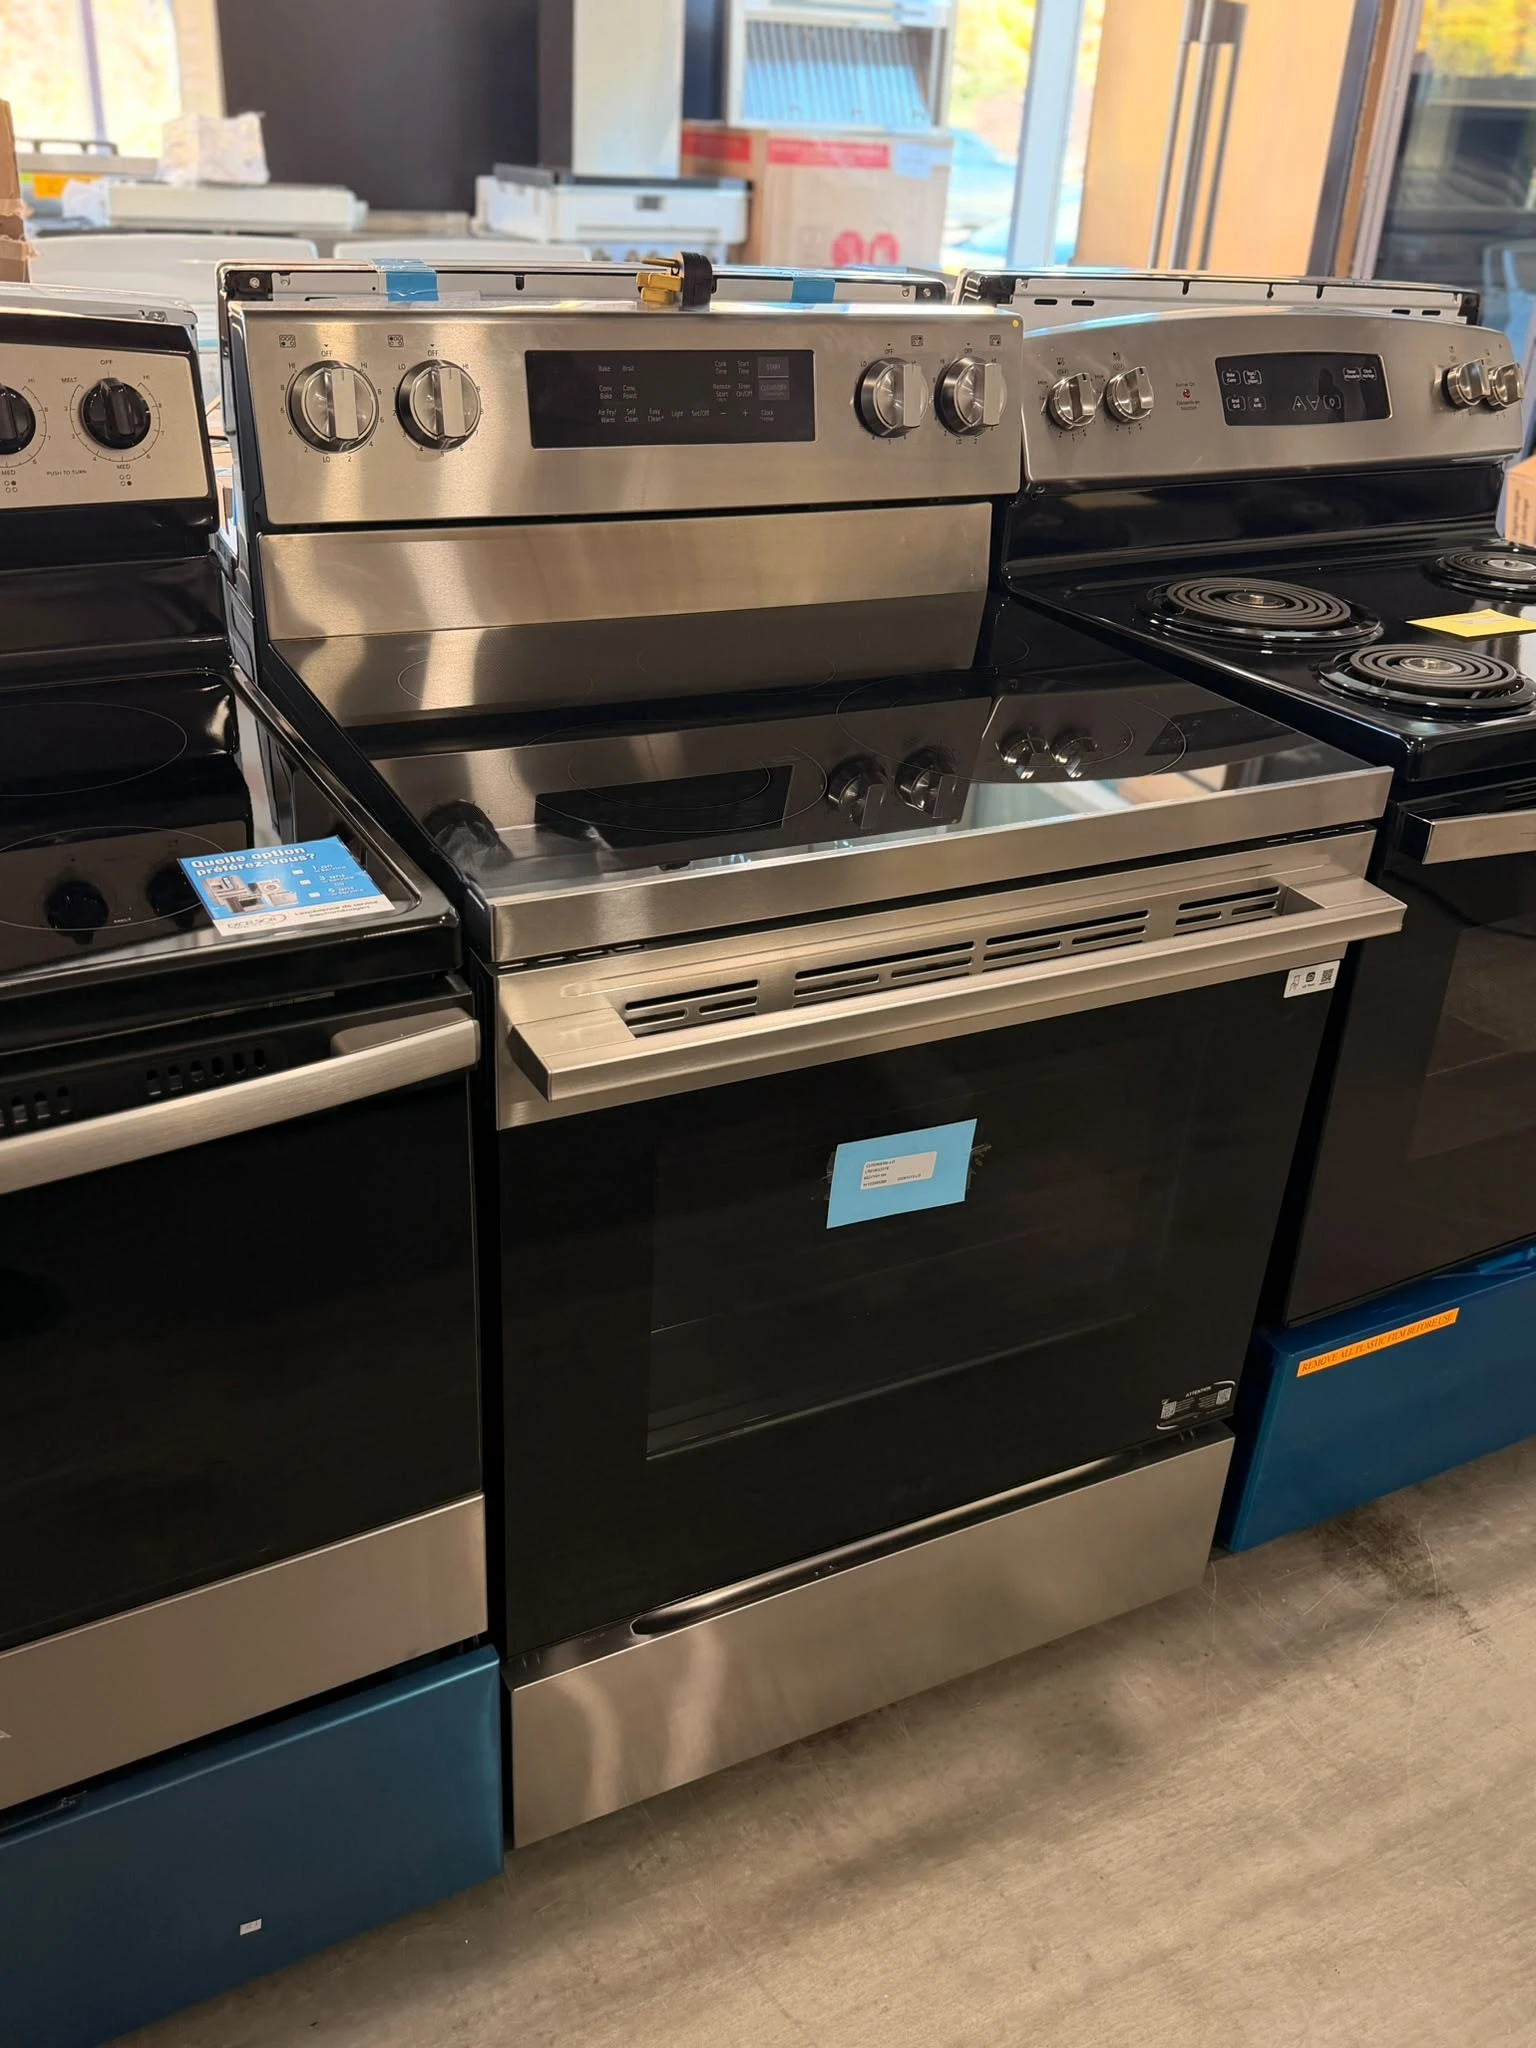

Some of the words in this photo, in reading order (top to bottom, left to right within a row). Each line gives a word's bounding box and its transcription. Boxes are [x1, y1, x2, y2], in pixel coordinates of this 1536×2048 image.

[190, 854, 247, 869] Quelle
[251, 846, 307, 861] option
[195, 852, 316, 877] préférez-vous?
[1302, 1353, 1338, 1372] REMOVE
[1340, 1349, 1354, 1363] ALL
[1356, 1338, 1388, 1356] PLASTIC
[1387, 1329, 1407, 1343] FILM
[1406, 1318, 1438, 1336] BEFORE
[1437, 1313, 1452, 1326] USE
[1185, 1386, 1212, 1397] ATTENTION
